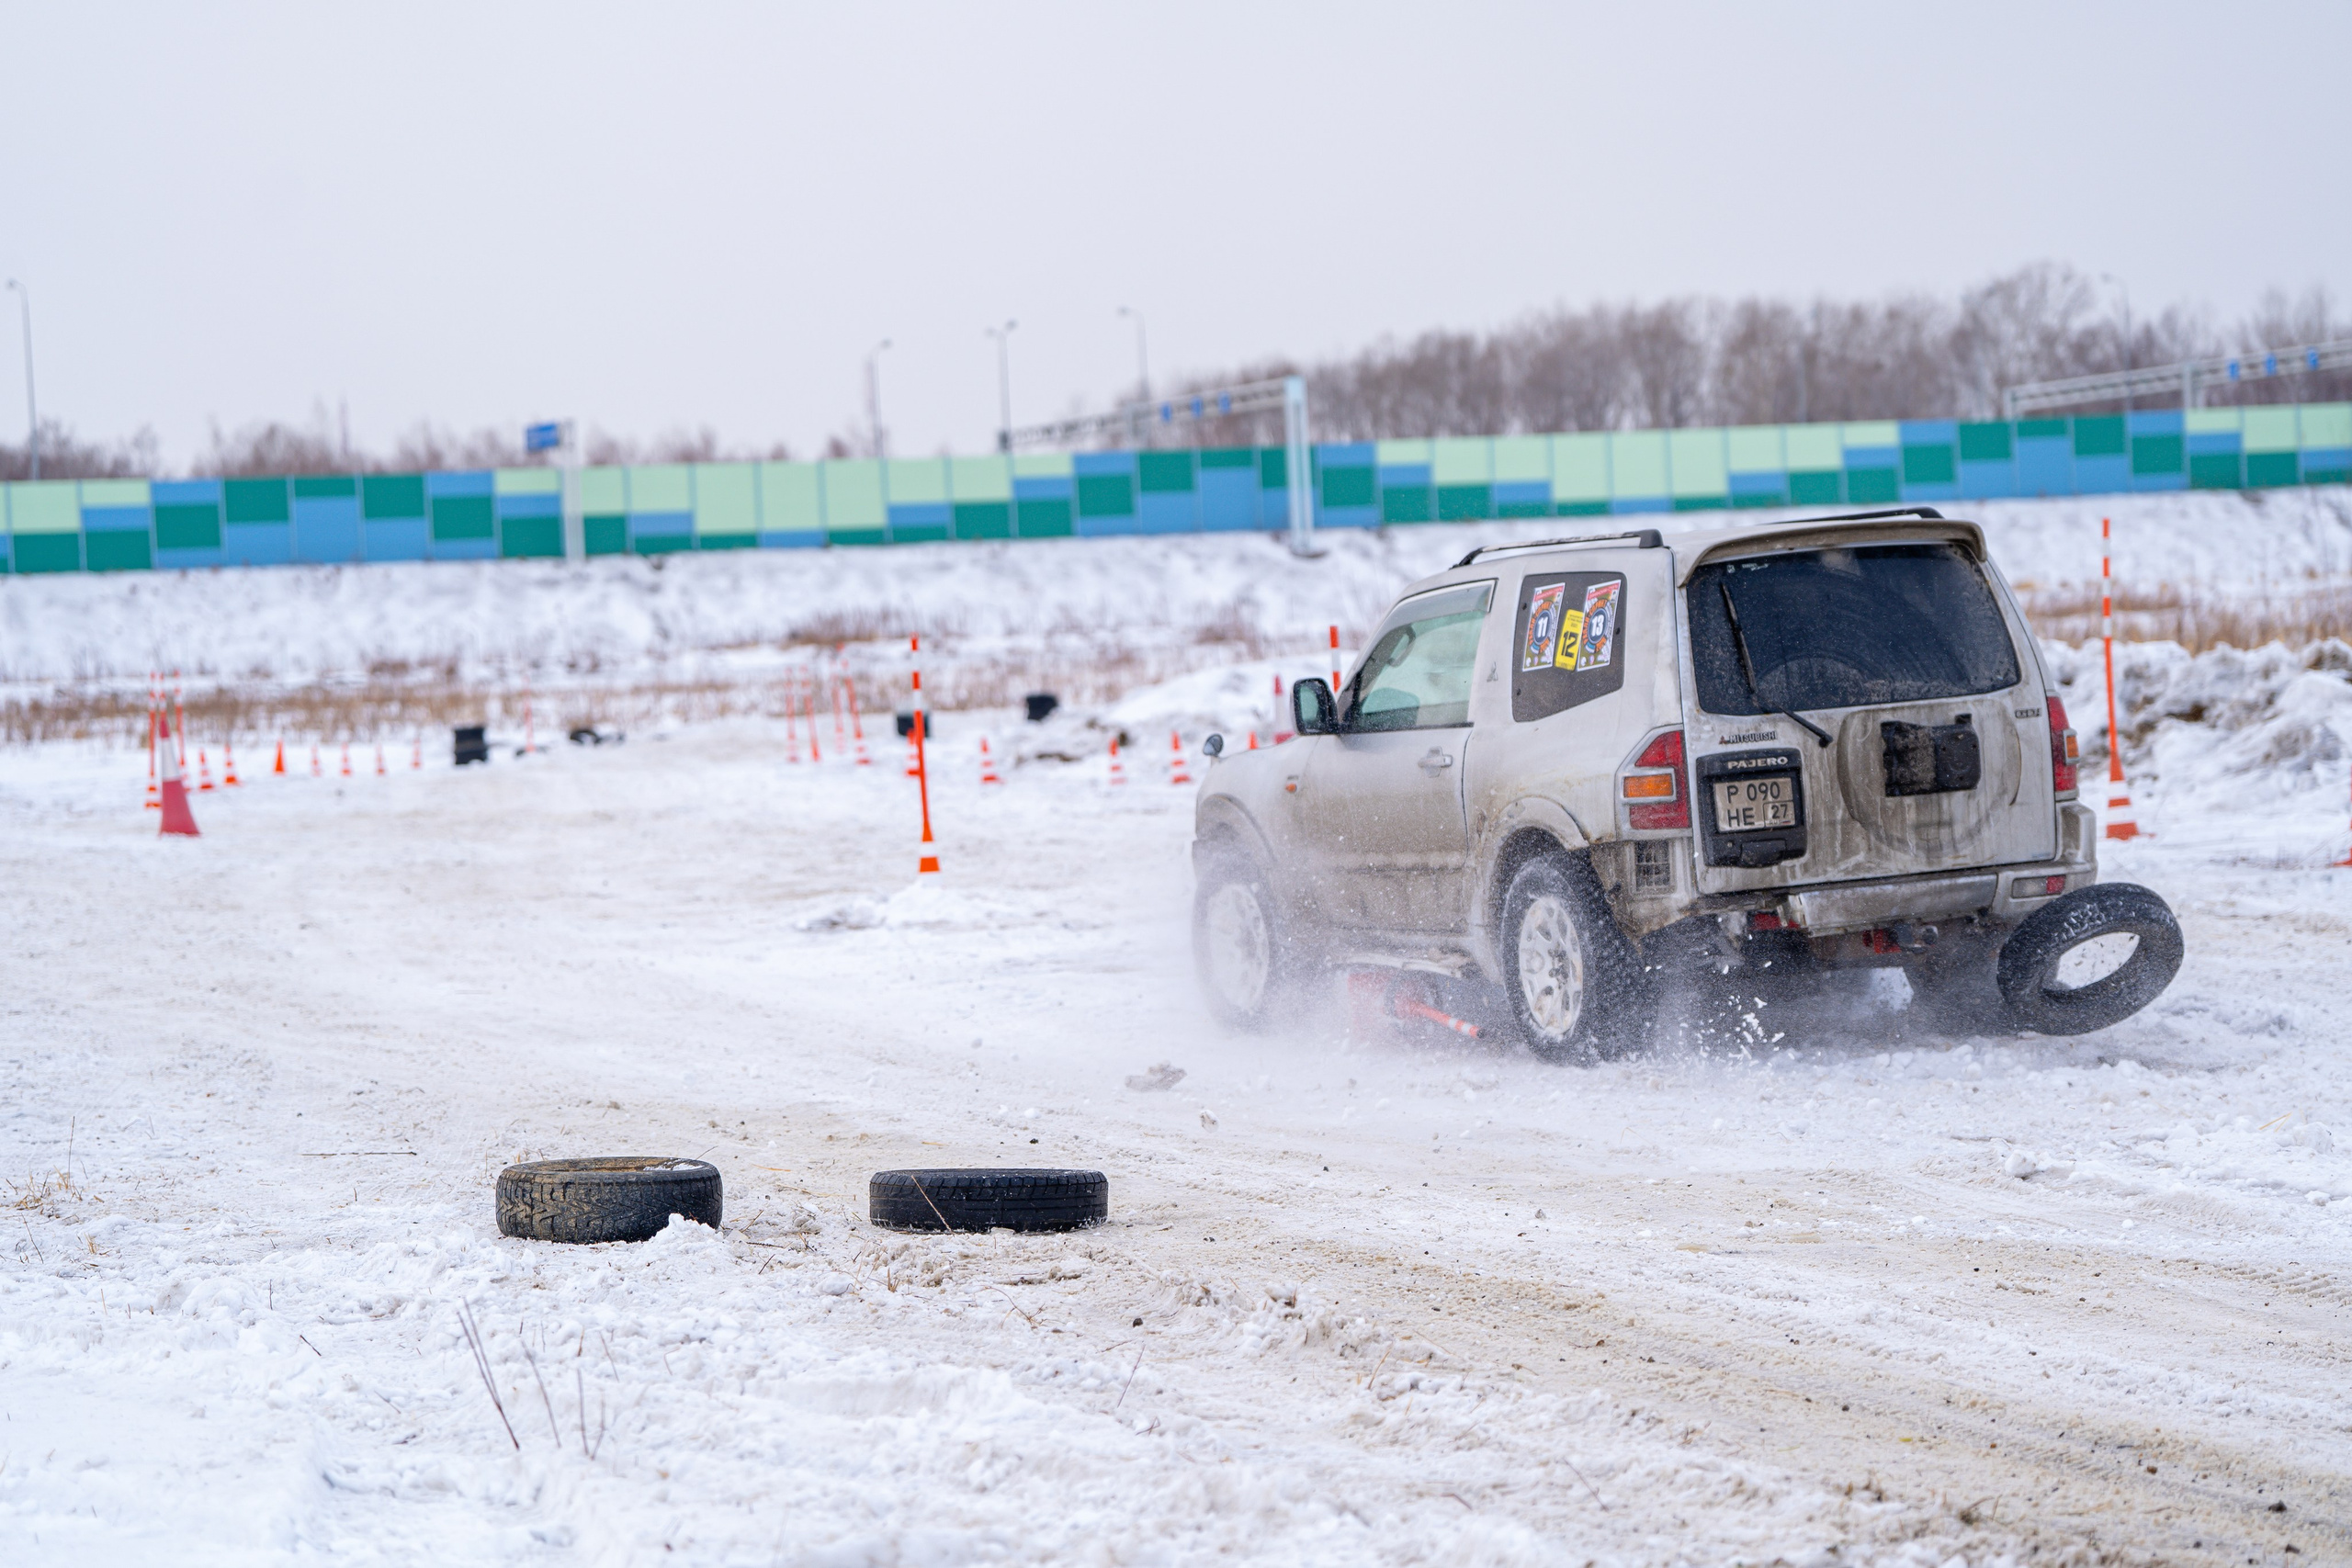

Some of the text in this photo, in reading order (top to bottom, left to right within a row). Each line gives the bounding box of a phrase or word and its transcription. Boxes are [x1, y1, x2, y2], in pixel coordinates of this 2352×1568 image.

[1537, 616, 1549, 637] 11
[1591, 615, 1605, 637] 13
[1561, 630, 1579, 659] 12
[1729, 731, 1778, 744] MITSUBISHI
[1727, 756, 1789, 770] PAJERO
[1747, 781, 1781, 801] 090
[1770, 804, 1788, 819] 27
